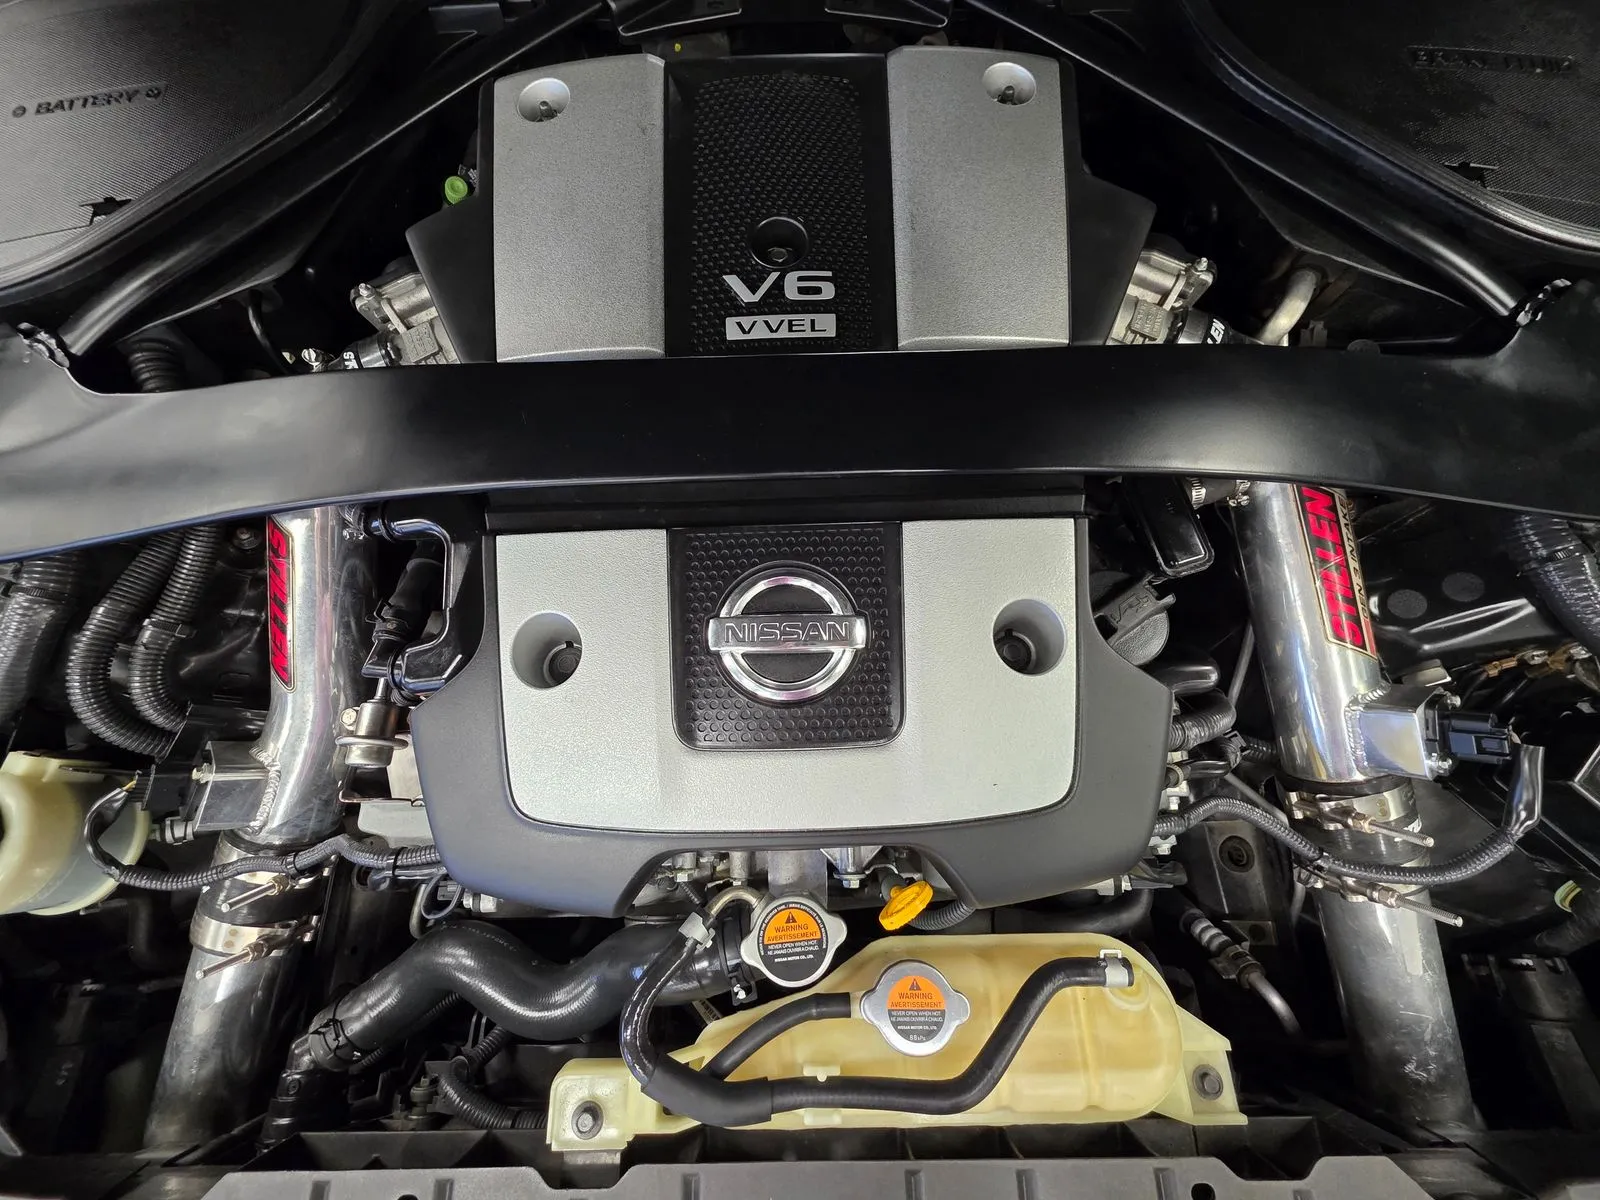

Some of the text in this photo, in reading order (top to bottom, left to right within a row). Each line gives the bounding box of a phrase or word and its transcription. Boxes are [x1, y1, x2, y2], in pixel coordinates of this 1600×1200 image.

[34, 89, 140, 116] BATTERY
[722, 270, 836, 303] V6
[735, 318, 827, 335] VVEL
[1337, 495, 1359, 563] INTAKE
[1301, 486, 1364, 647] STILLEN
[268, 518, 289, 683] STILLEN
[724, 621, 850, 642] NISSAN
[766, 931, 818, 942] AVERTISSEMENT
[774, 924, 809, 933] WARNING
[898, 992, 933, 1000] WARNING
